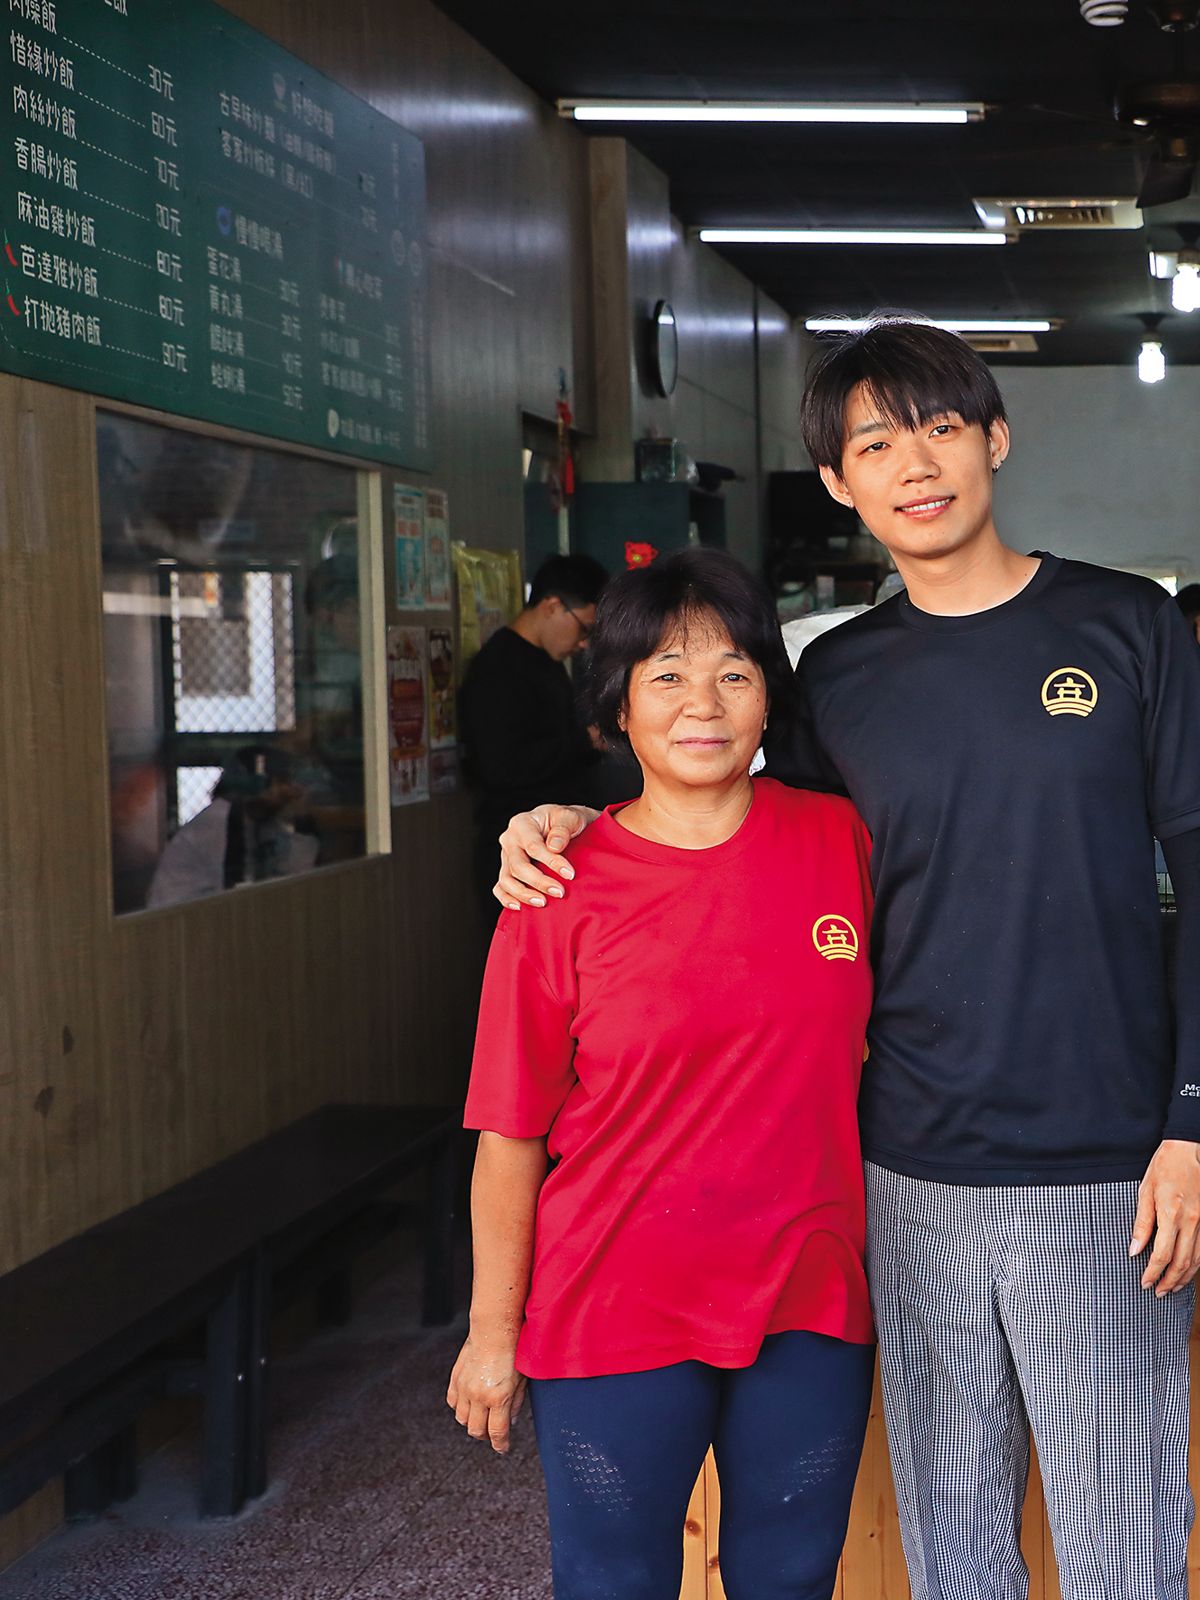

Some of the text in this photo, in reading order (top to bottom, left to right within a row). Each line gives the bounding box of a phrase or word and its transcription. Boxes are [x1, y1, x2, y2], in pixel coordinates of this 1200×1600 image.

[10, 29, 74, 91] 惜緣炒飯
[13, 84, 77, 140] 肉絲炒飯
[14, 136, 78, 191] 香腸炒飯
[17, 191, 96, 248] 麻油雞炒飯
[20, 244, 99, 298] 芭達雅炒飯
[24, 295, 102, 346] 打拋豬肉飯
